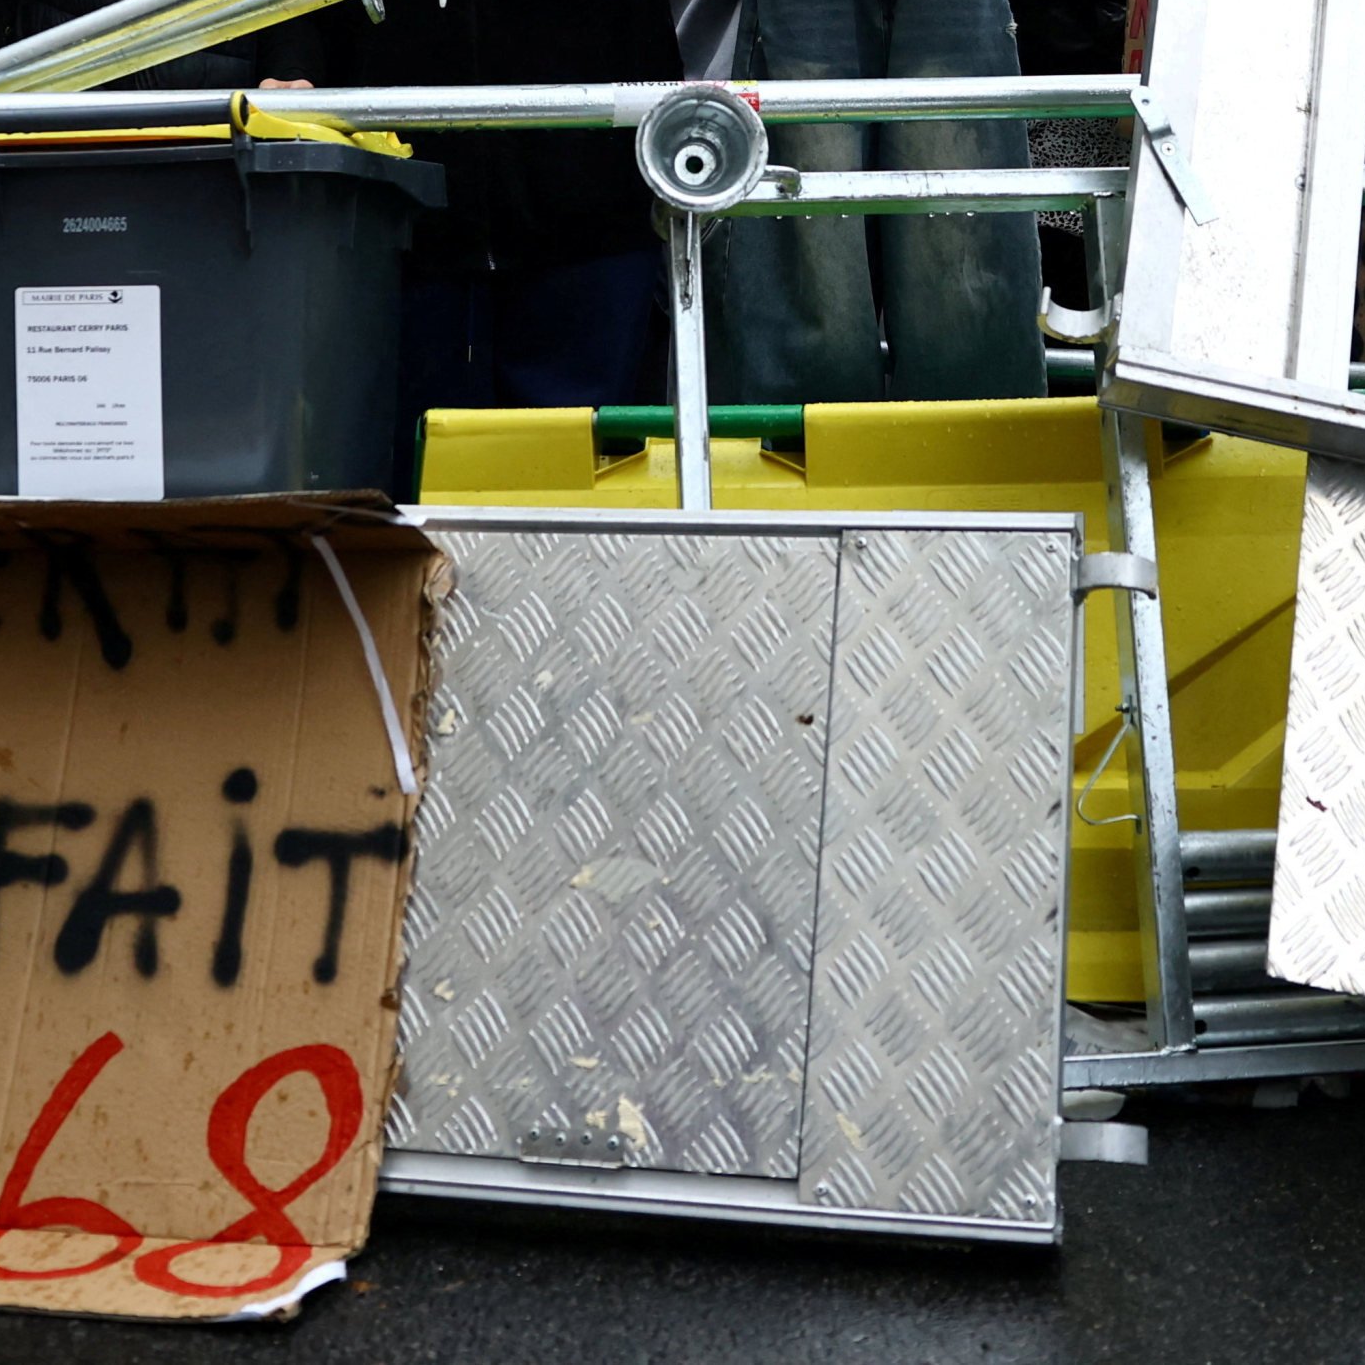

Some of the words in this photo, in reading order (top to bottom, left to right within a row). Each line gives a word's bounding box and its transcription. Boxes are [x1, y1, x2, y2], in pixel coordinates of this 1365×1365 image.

[64, 294, 75, 302] DE
[78, 293, 103, 301] PARIS
[27, 324, 76, 333] RESTAURANT
[105, 323, 128, 332] PARIS
